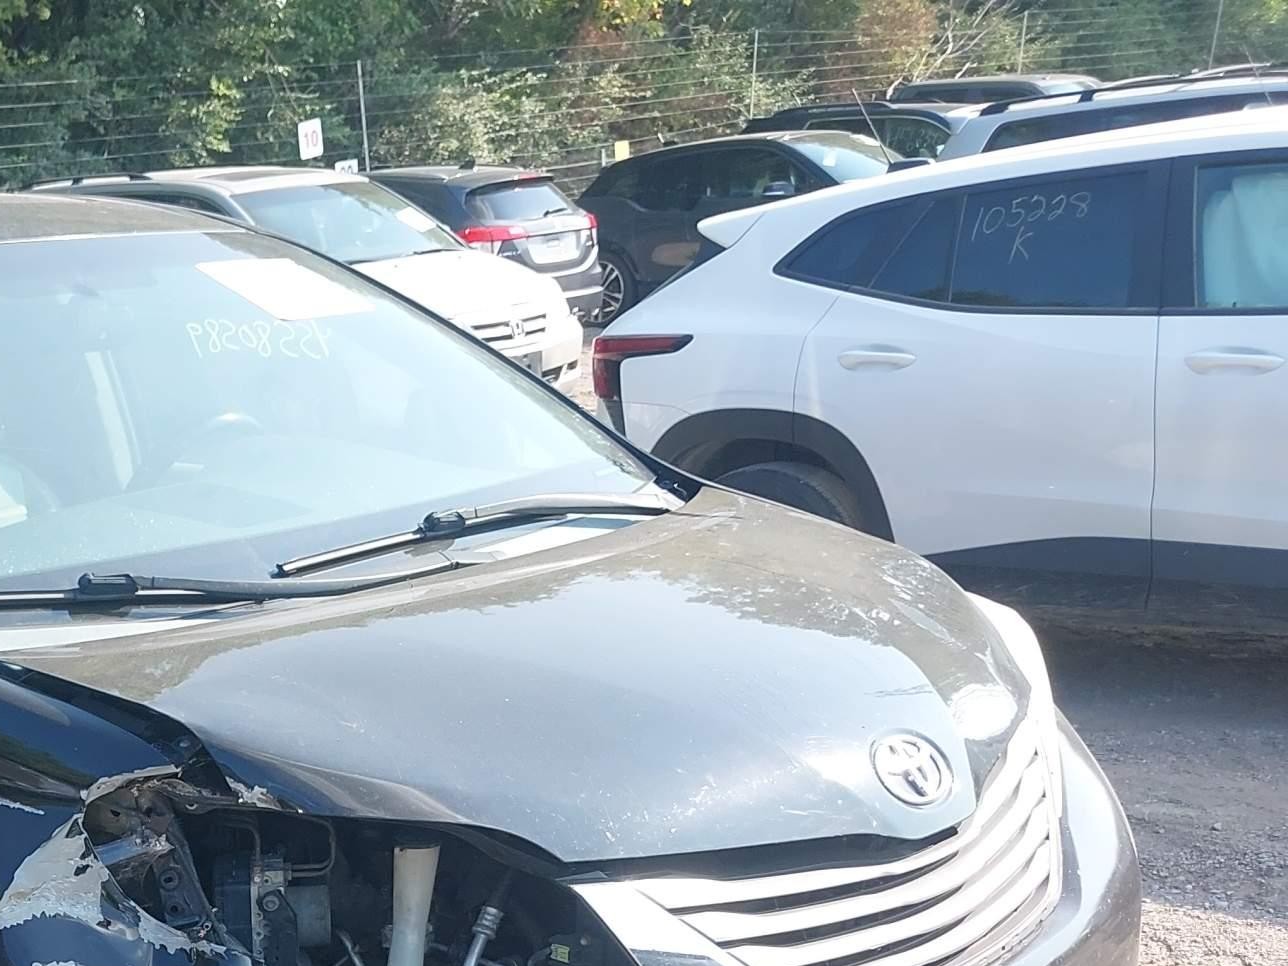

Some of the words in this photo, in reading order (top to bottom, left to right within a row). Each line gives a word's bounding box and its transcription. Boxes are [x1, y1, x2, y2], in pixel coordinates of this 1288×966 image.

[303, 129, 319, 149] 10
[970, 191, 1091, 242] 105228
[1007, 226, 1034, 265] K
